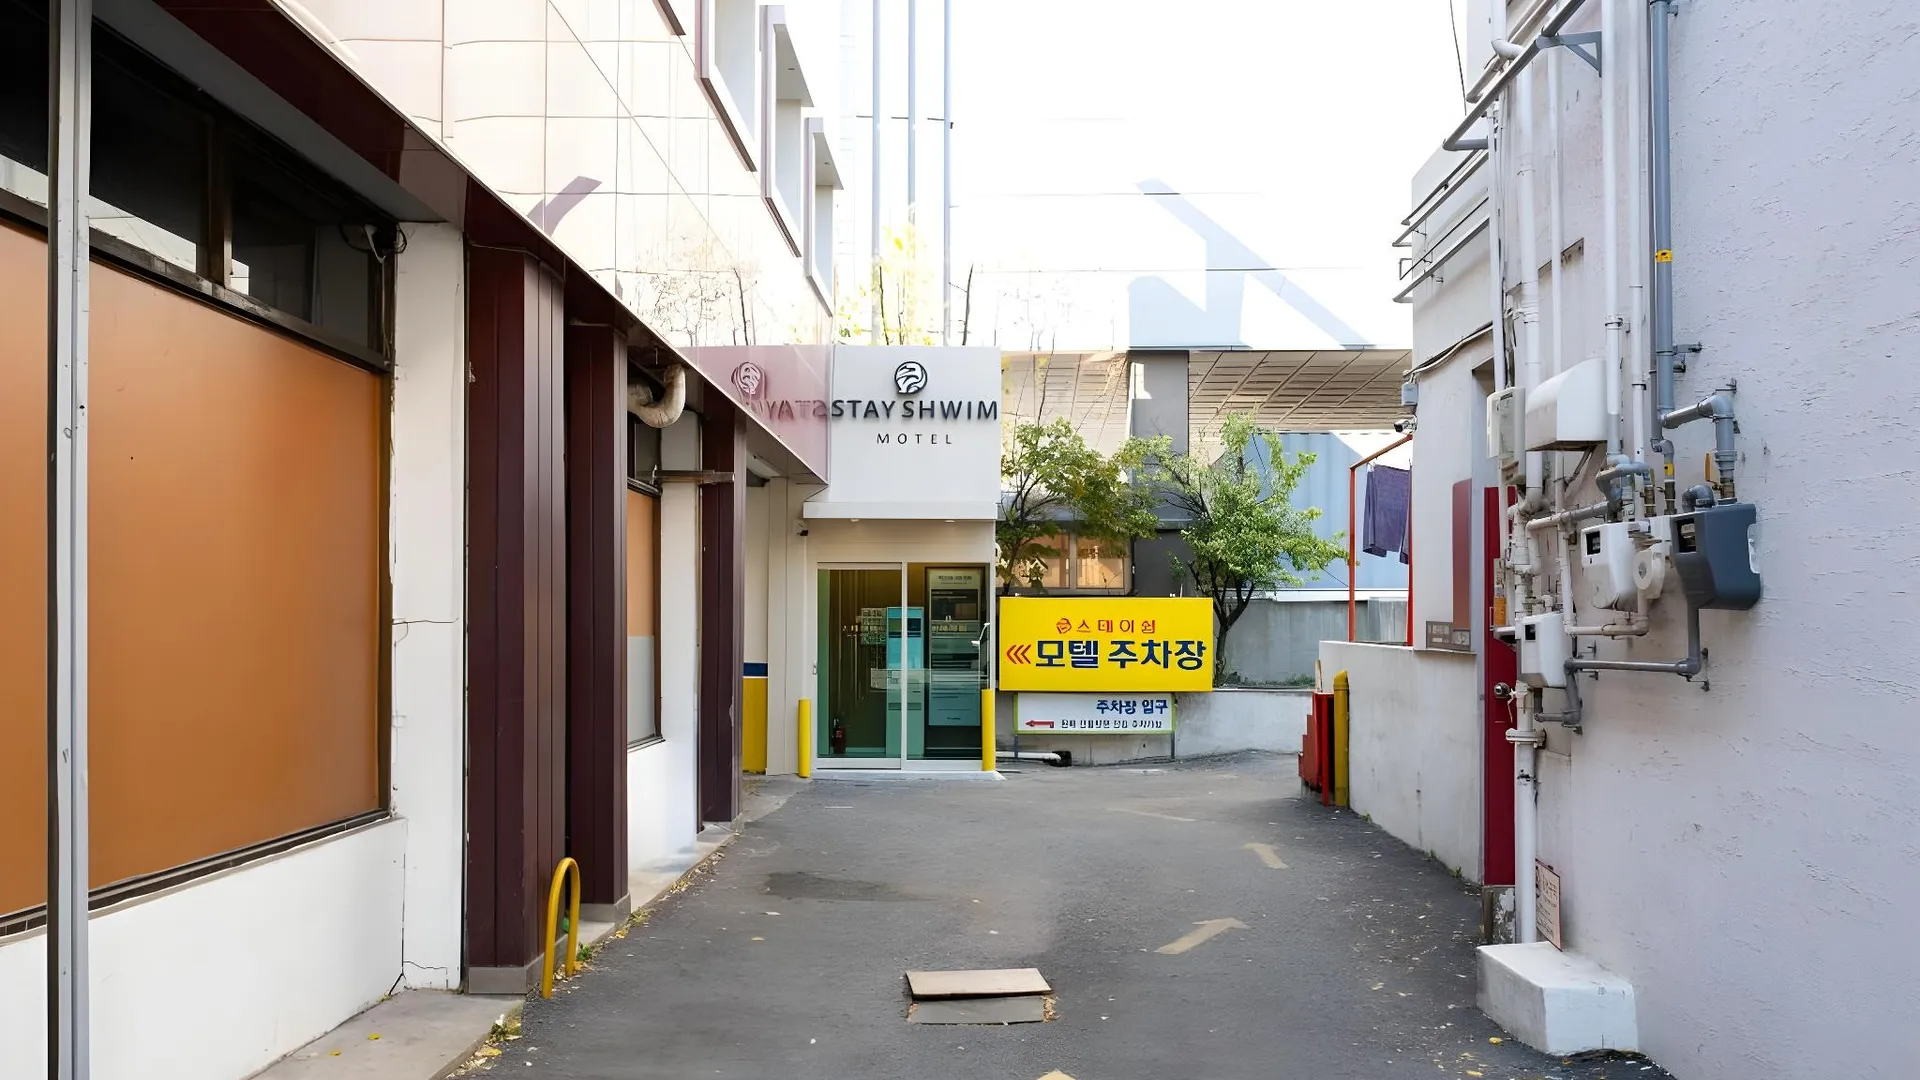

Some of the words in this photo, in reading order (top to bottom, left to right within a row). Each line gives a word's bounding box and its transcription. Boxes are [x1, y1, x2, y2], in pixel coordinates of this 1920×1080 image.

[831, 399, 896, 421] STAY
[902, 399, 999, 421] SHWIM
[876, 433, 952, 445] MOTEL
[1035, 640, 1099, 669] 모텔
[1107, 640, 1207, 671] 주차장
[1096, 699, 1137, 715] 주차장
[1141, 699, 1168, 715] 입구
